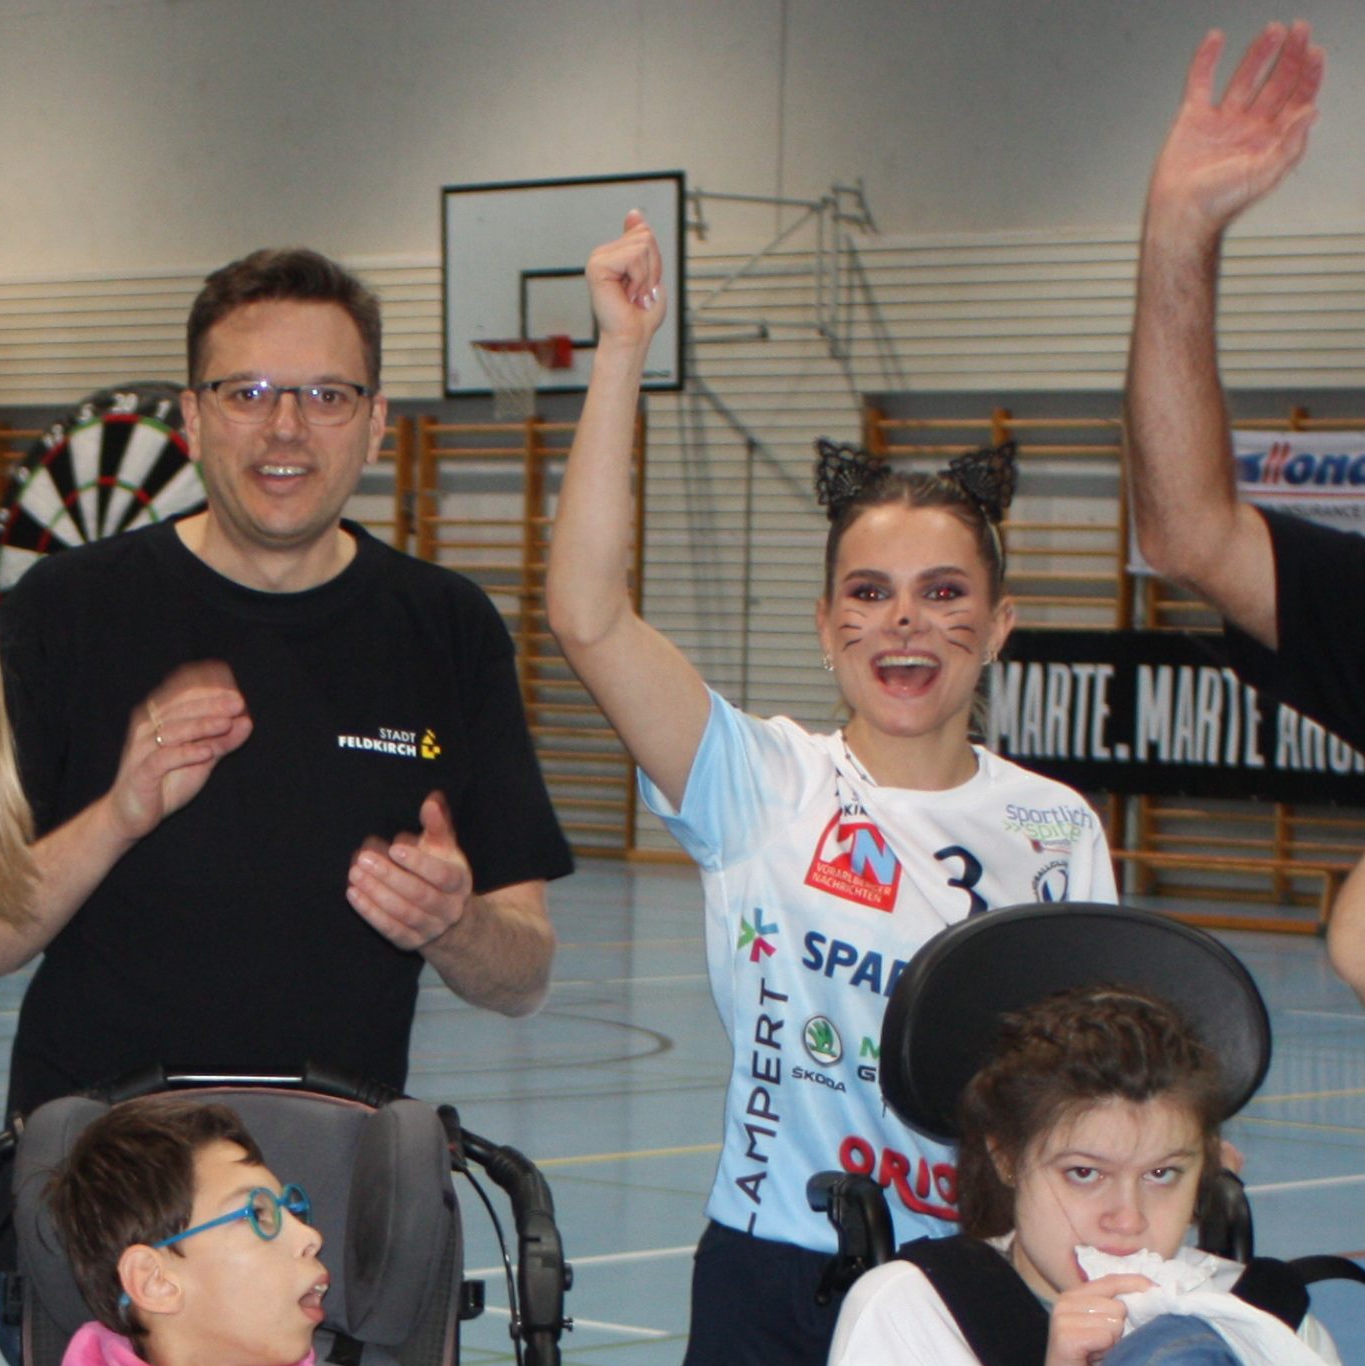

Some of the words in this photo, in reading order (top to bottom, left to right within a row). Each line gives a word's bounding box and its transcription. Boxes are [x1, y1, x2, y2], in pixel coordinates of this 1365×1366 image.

[337, 735, 417, 757] FELDKIRCH
[378, 727, 417, 744] STADT
[1006, 804, 1093, 829] sportlich
[1025, 823, 1082, 842] spite
[735, 977, 790, 1236] AMPERT
[839, 1136, 959, 1221] ORIO
